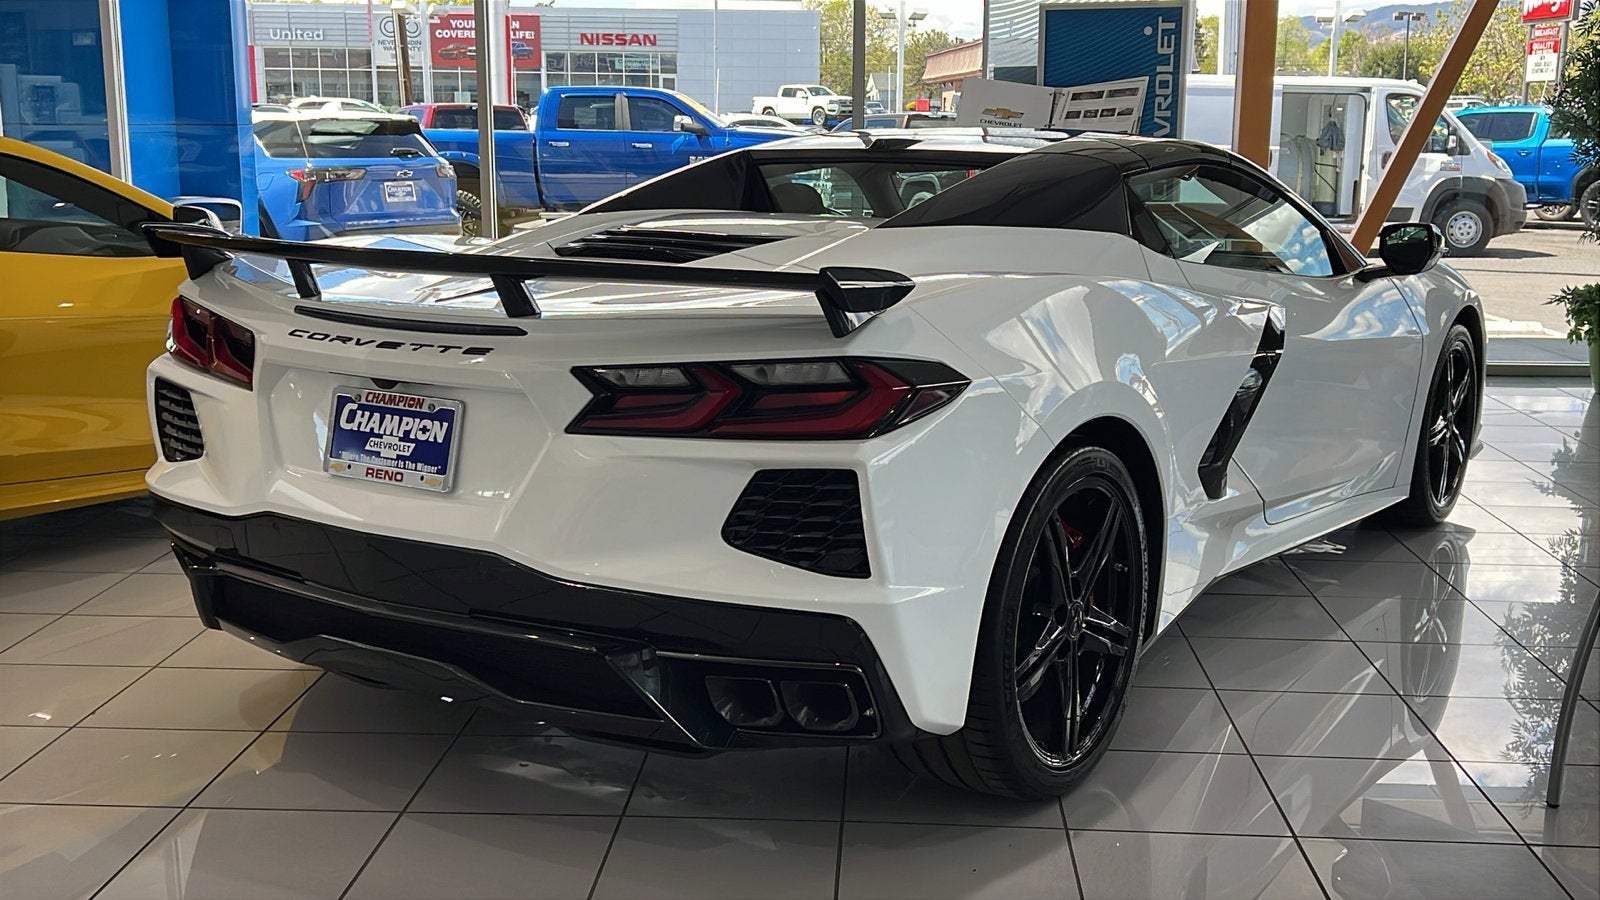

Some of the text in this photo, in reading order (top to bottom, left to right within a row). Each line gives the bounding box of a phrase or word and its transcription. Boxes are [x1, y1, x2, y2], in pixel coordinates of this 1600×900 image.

[269, 27, 323, 40] United
[435, 29, 534, 39] COVERE LIFE!
[580, 32, 657, 46] NISSAN
[1532, 42, 1555, 50] QUALITY
[1153, 16, 1176, 137] VROLET
[979, 118, 1023, 128] CHEVROLET
[288, 328, 495, 356] CORVETTE
[365, 391, 426, 410] CHAMPION
[368, 439, 411, 454] CHEVROLET
[360, 453, 371, 463] The
[371, 455, 398, 467] Customer
[398, 459, 404, 468] Is
[405, 460, 416, 470] The
[365, 466, 404, 483] RENO
